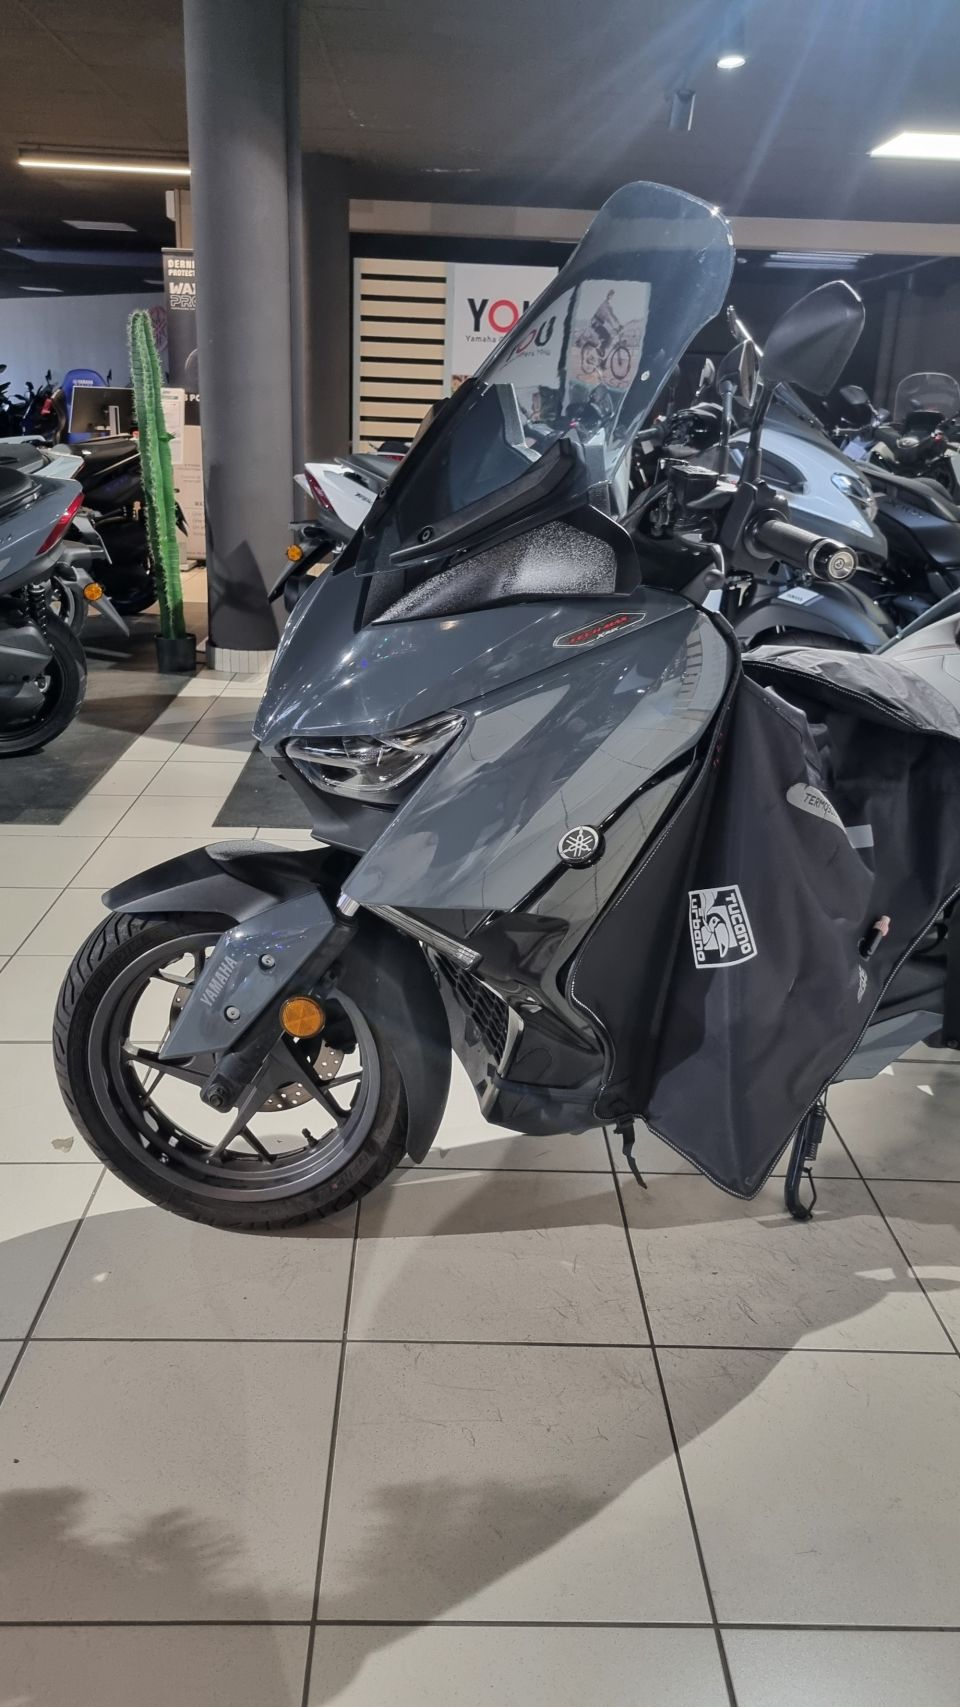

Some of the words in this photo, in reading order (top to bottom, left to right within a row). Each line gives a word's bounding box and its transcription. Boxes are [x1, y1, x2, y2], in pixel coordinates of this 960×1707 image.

[167, 259, 195, 269] DERNI
[467, 298, 530, 332] YO
[200, 955, 238, 1007] YAMAHA
